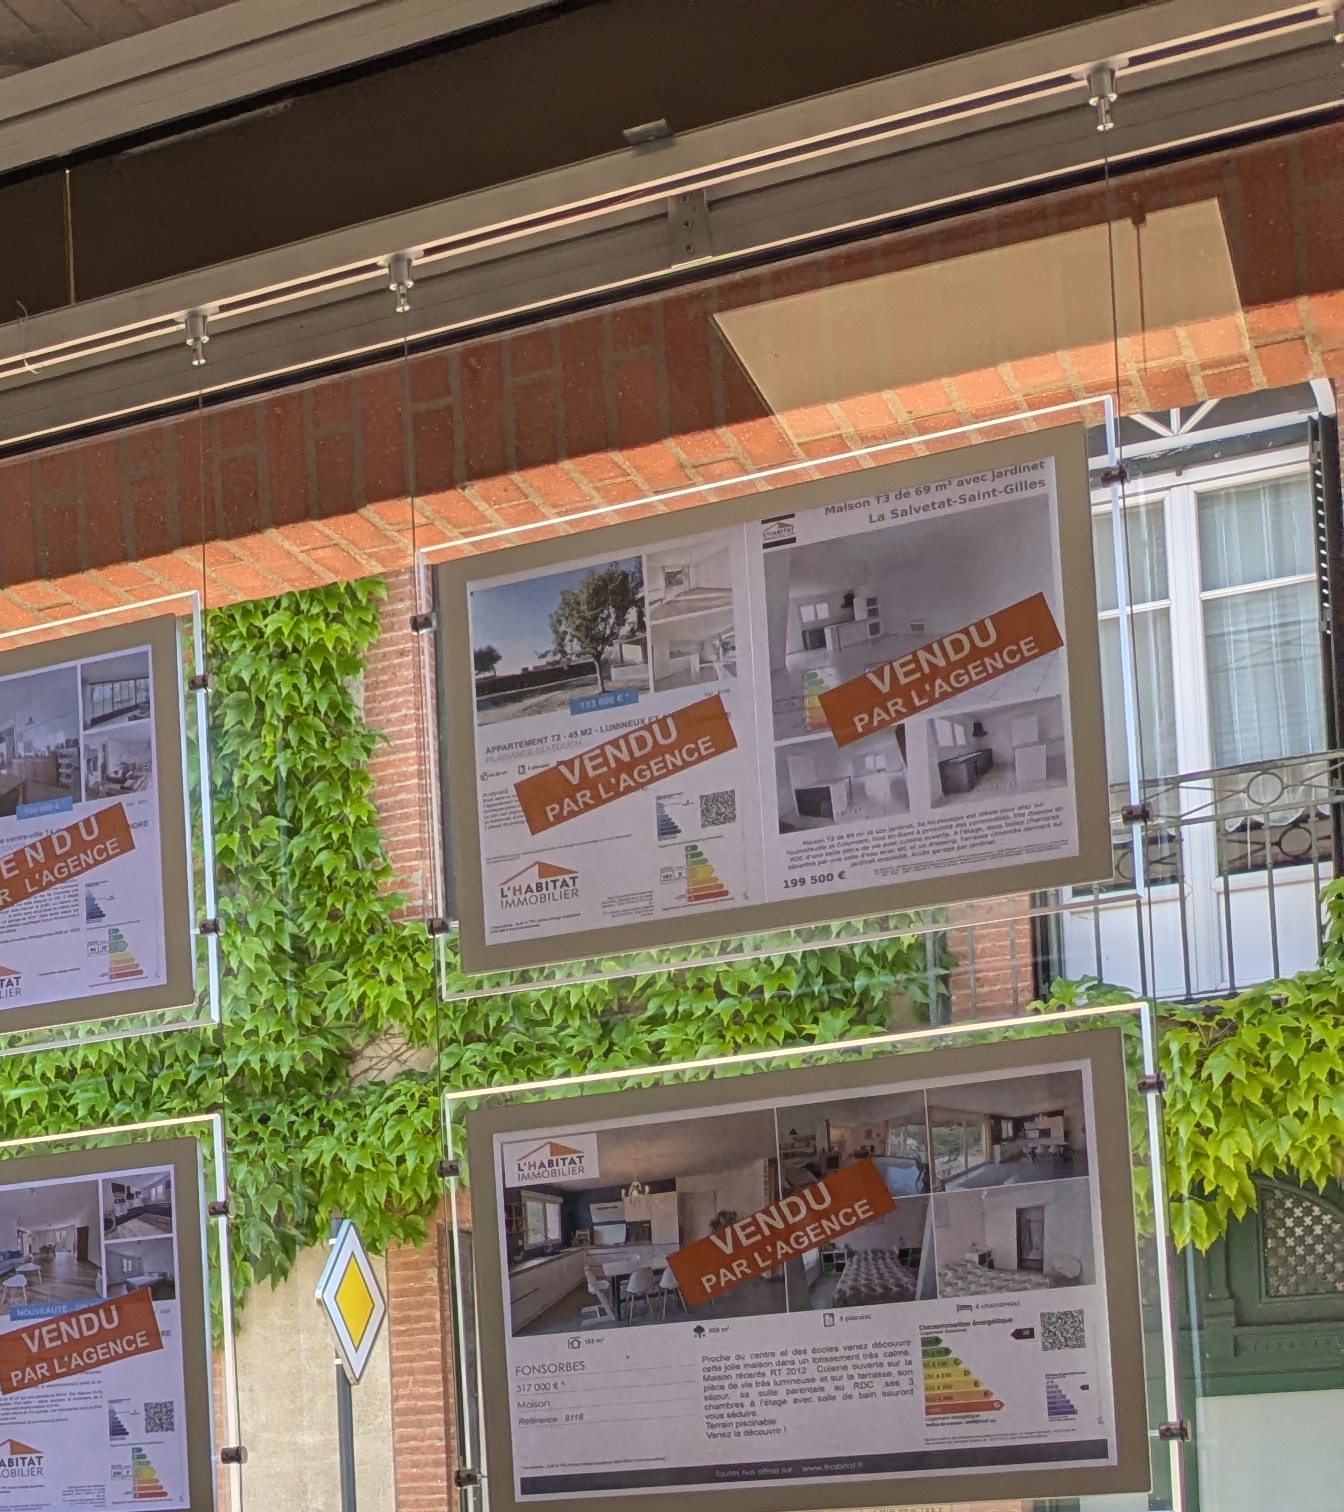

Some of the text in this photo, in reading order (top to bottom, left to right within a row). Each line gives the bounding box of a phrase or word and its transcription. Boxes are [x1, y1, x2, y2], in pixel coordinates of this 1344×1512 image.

[824, 499, 870, 516] Maison
[876, 494, 890, 505] T3
[895, 490, 910, 500] de
[915, 485, 930, 498] 69
[957, 474, 987, 487] avec
[991, 460, 1044, 482] jardinet
[869, 478, 1045, 524] La Salvetat-Saint-Gilles
[867, 617, 997, 694] VENDU
[853, 636, 1039, 733] PAR L'AGENCE
[486, 736, 548, 754] APPARTEMENT
[558, 716, 678, 786] VENDU
[545, 788, 595, 822] PAR
[599, 735, 715, 799] L'AGENCE
[25, 837, 120, 893] L'AGENCE
[500, 876, 578, 898] L'HABITAT
[783, 871, 845, 888] 199 500 €
[501, 888, 579, 909] IMMOBILIER
[517, 1155, 585, 1172] L'HABITAT
[517, 1165, 585, 1182] IMMOBILIER
[710, 1181, 832, 1255] VENDU
[701, 1199, 874, 1294] PAR L'AGENCE
[22, 1305, 120, 1353] VENDU
[10, 1330, 149, 1387] PAR L'AGENCE
[702, 1355, 730, 1363] Proche
[750, 1351, 775, 1359] centre
[843, 1343, 868, 1351] venez
[743, 1361, 774, 1369] maison
[776, 1359, 795, 1367] dans
[515, 1361, 585, 1376] FONSORBES
[703, 1374, 732, 1382] Maison
[786, 1367, 806, 1375] 2012
[534, 1382, 551, 1392] 000
[517, 1400, 550, 1408] Maison
